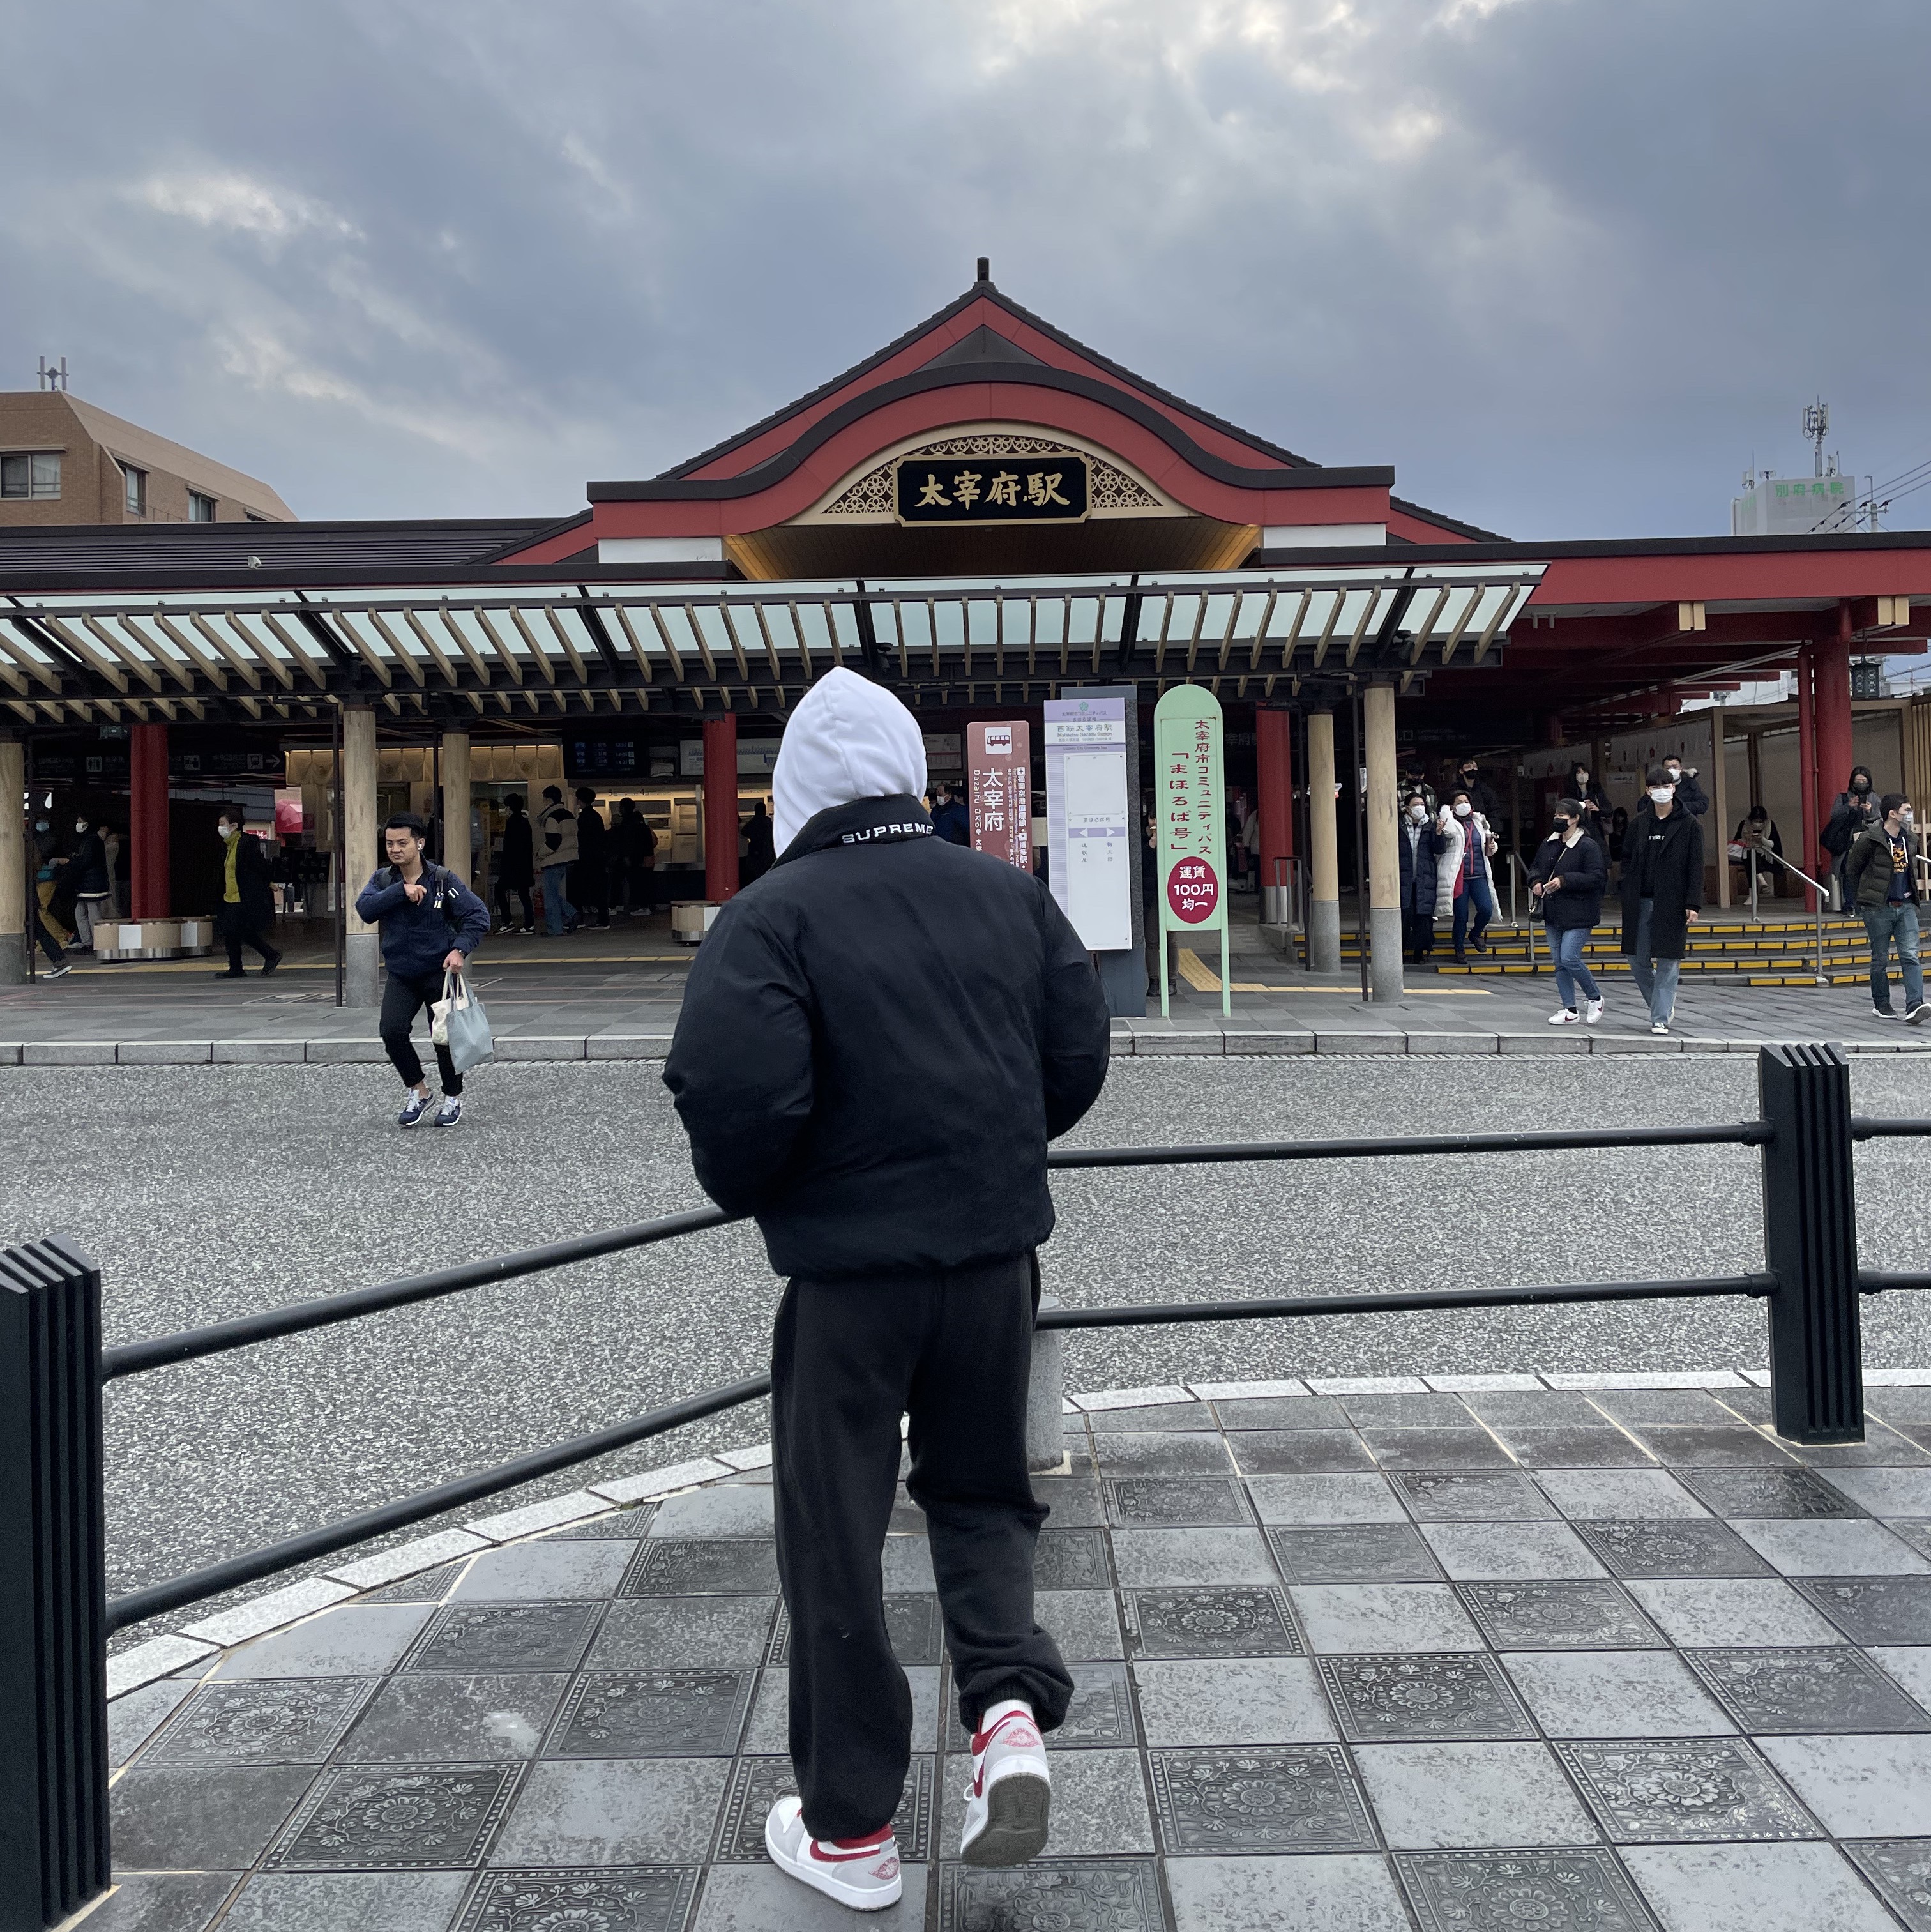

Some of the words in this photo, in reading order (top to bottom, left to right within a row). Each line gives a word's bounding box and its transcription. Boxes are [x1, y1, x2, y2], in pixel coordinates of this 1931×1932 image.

[914, 470, 1070, 510] 太宰府駅
[1057, 724, 1112, 733] 西鉄太宰府駅
[973, 769, 981, 803] Dazaifu
[983, 767, 1004, 832] 太宰府
[1194, 720, 1212, 855] 太宰府市コミュニティバス
[1170, 752, 1192, 850] 「まほろば号」
[842, 823, 934, 844] SUPREME
[1179, 865, 1206, 879] 運賃
[1174, 883, 1214, 896] 100円
[1181, 897, 1208, 911] 均一
